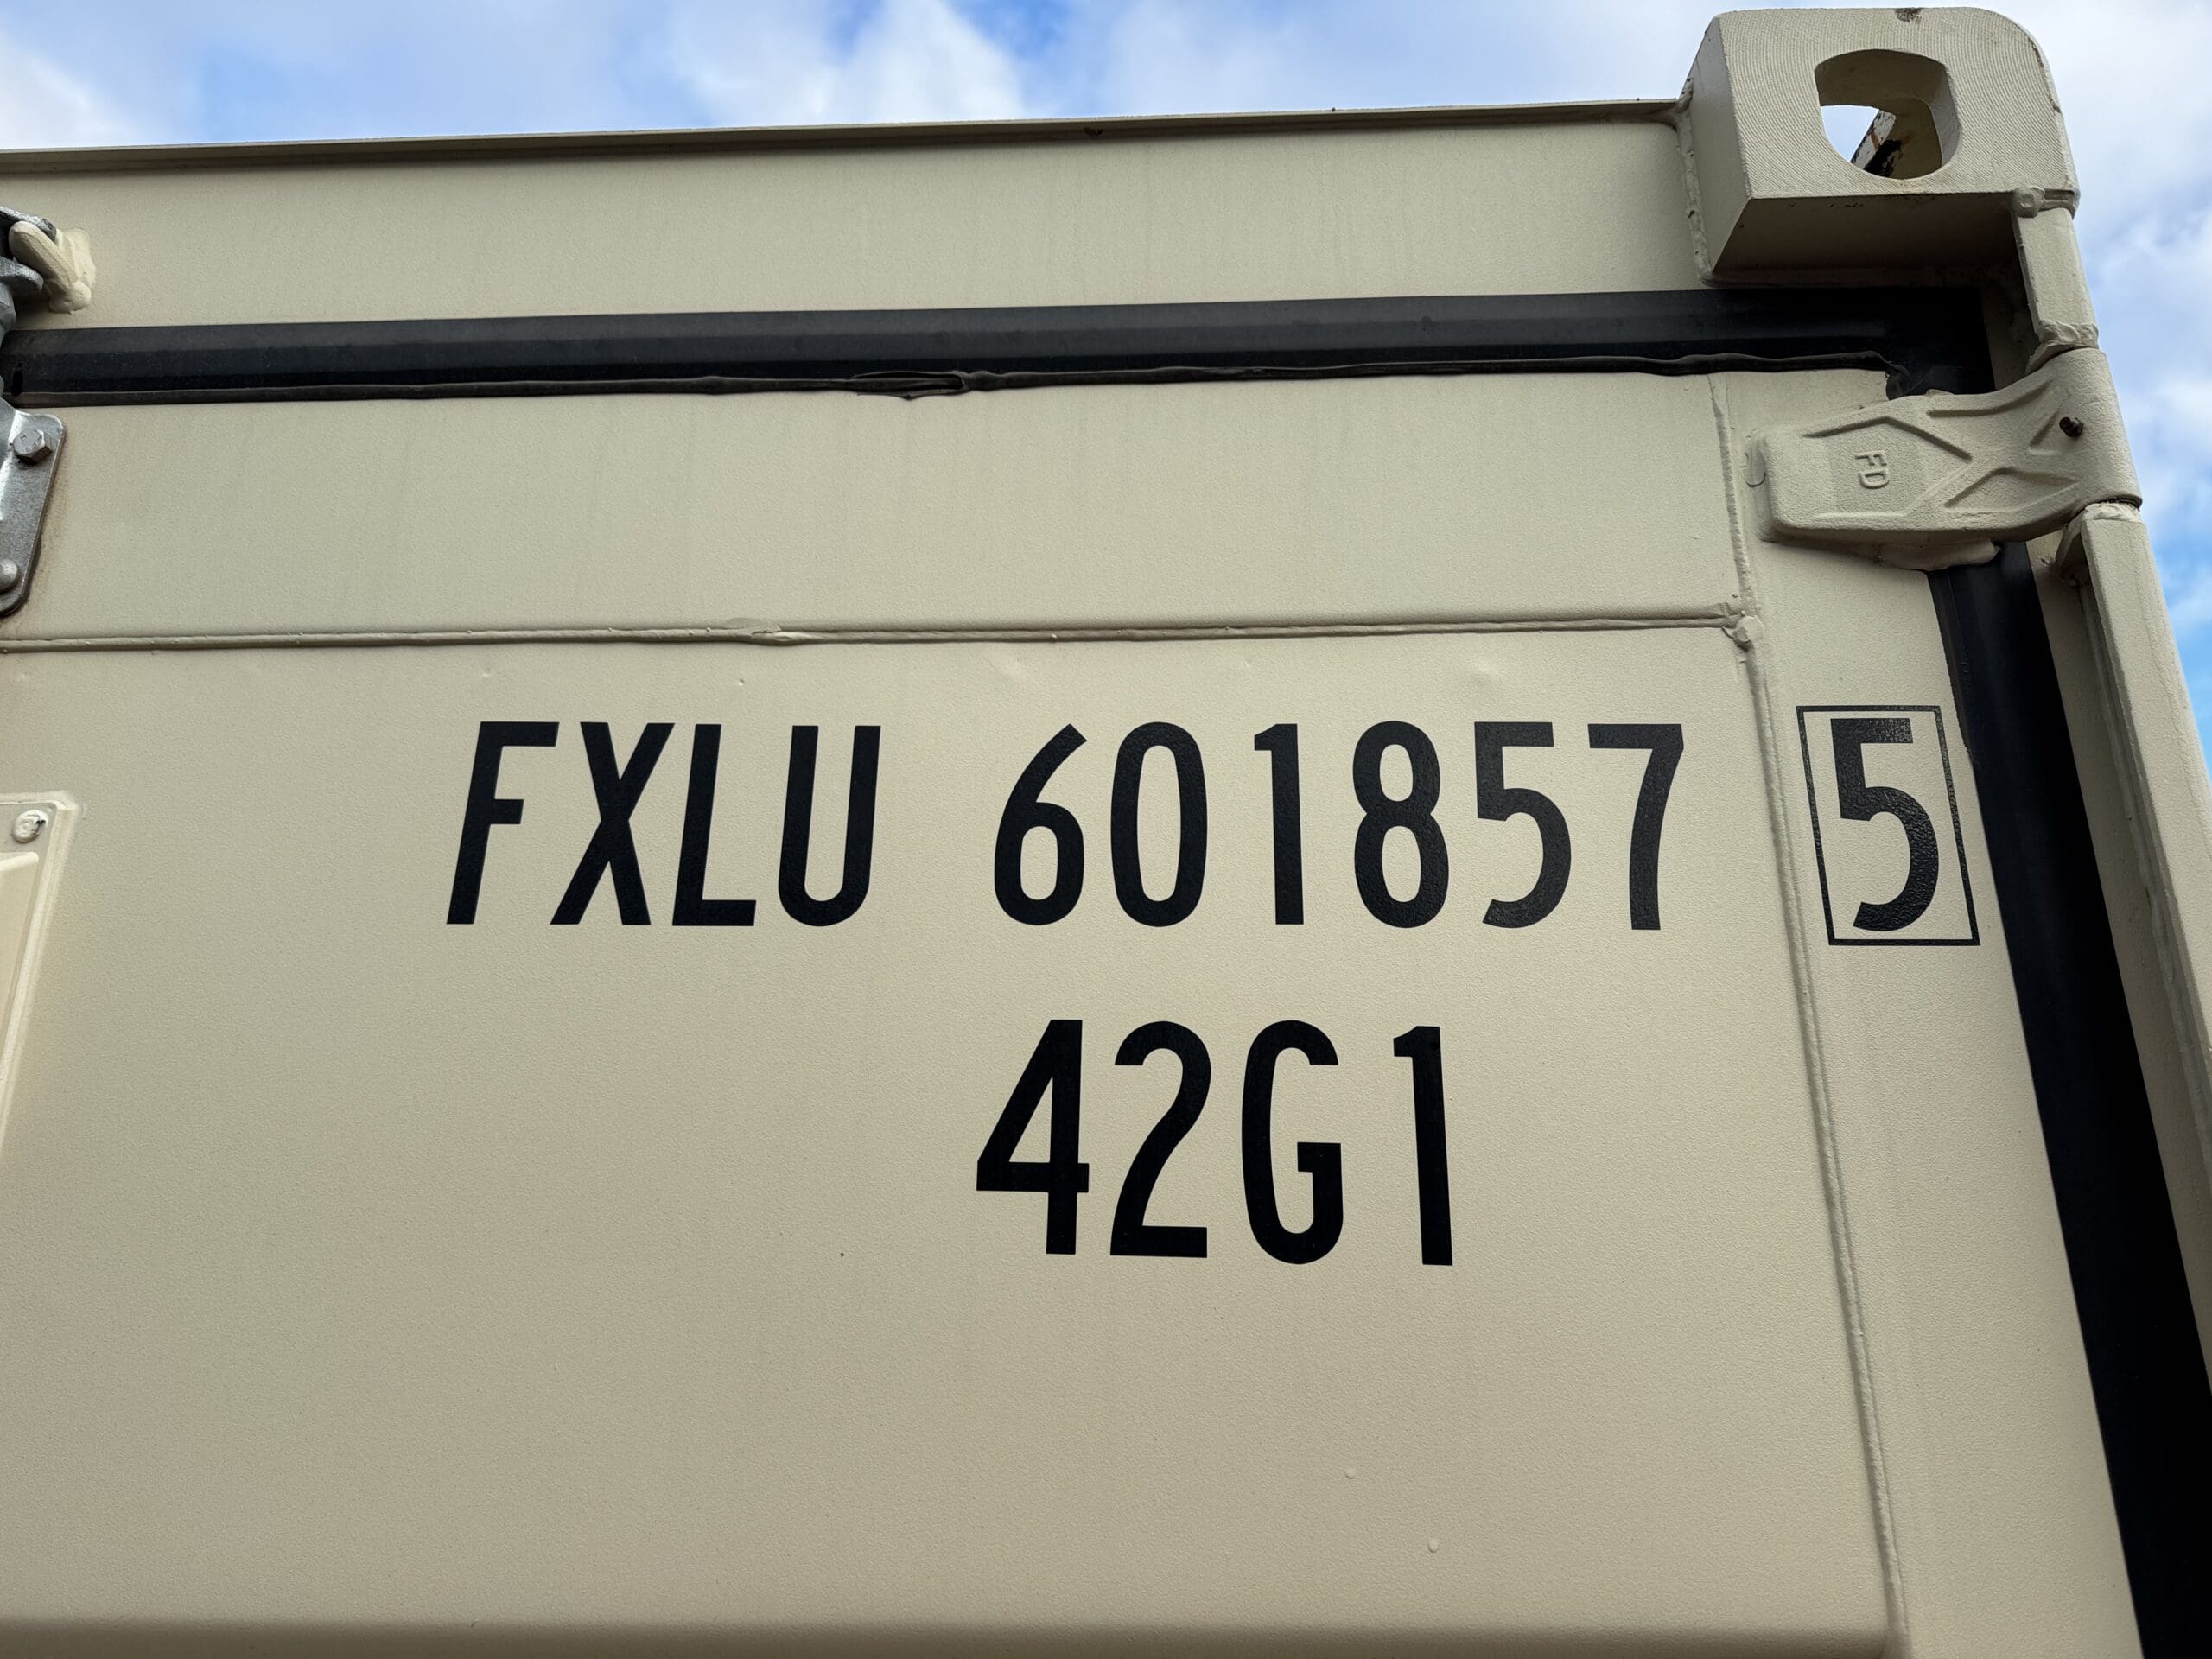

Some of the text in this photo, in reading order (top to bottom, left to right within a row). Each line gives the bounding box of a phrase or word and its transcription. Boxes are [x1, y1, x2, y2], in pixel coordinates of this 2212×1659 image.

[1853, 449, 1891, 490] FD
[447, 717, 1940, 932] FXLU 601857 5
[976, 1020, 1453, 1267] 42G1
